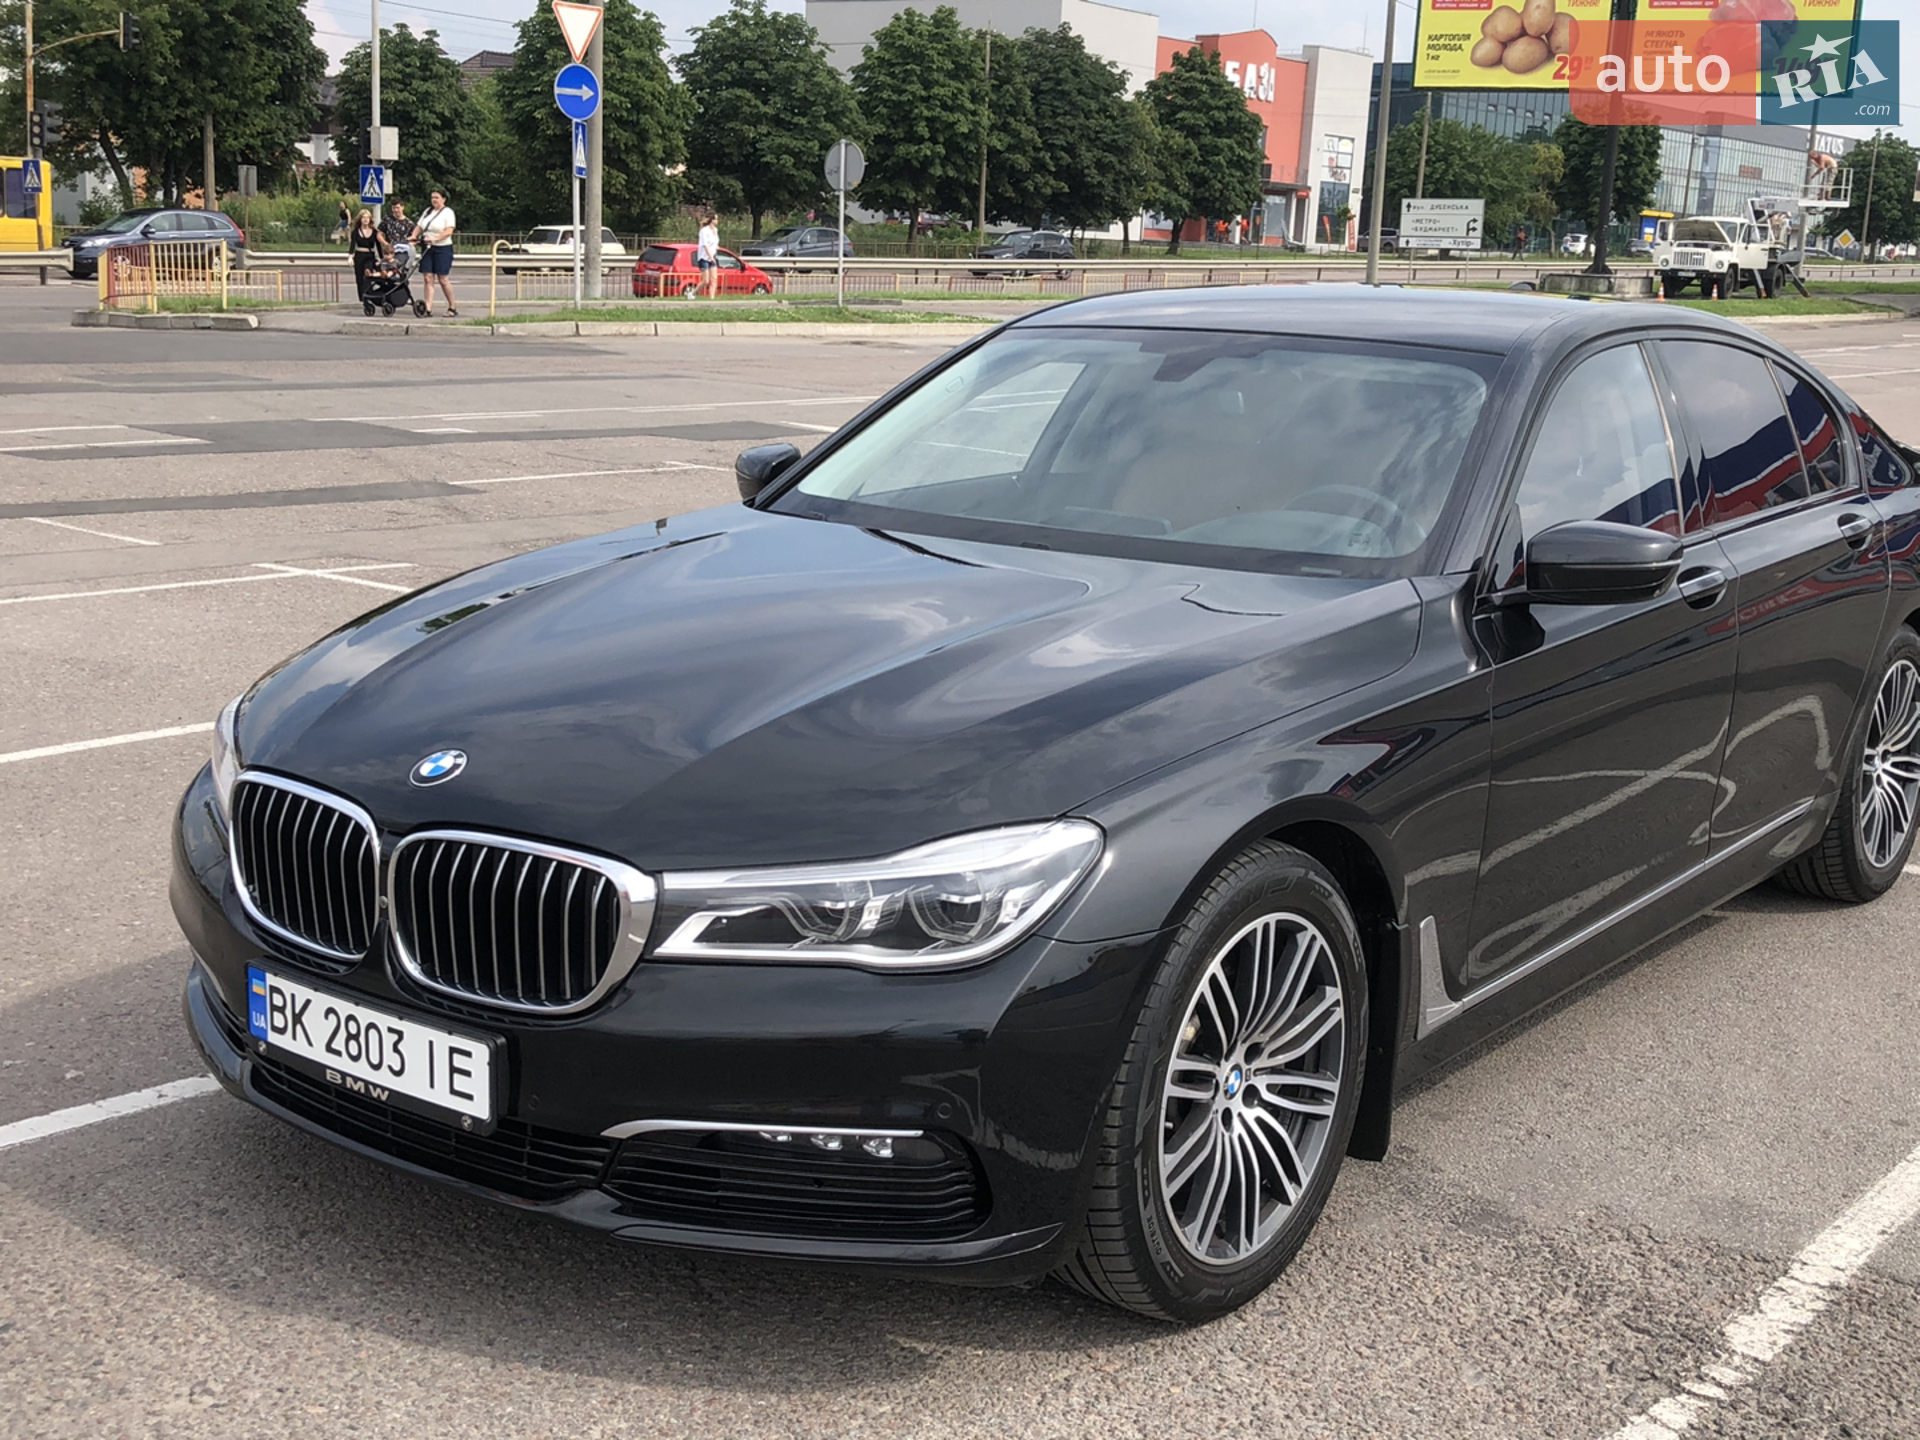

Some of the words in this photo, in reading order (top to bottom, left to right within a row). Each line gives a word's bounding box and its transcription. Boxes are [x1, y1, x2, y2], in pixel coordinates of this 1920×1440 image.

[1426, 43, 1464, 52] МОЛОДА,
[1427, 33, 1472, 42] КАРТОПЛЯ
[1552, 55, 1584, 80] 29
[252, 1010, 267, 1030] UA
[269, 984, 315, 1048] BK
[323, 1006, 406, 1078] 2803
[428, 1039, 475, 1102] IE
[325, 1068, 390, 1102] BMW
